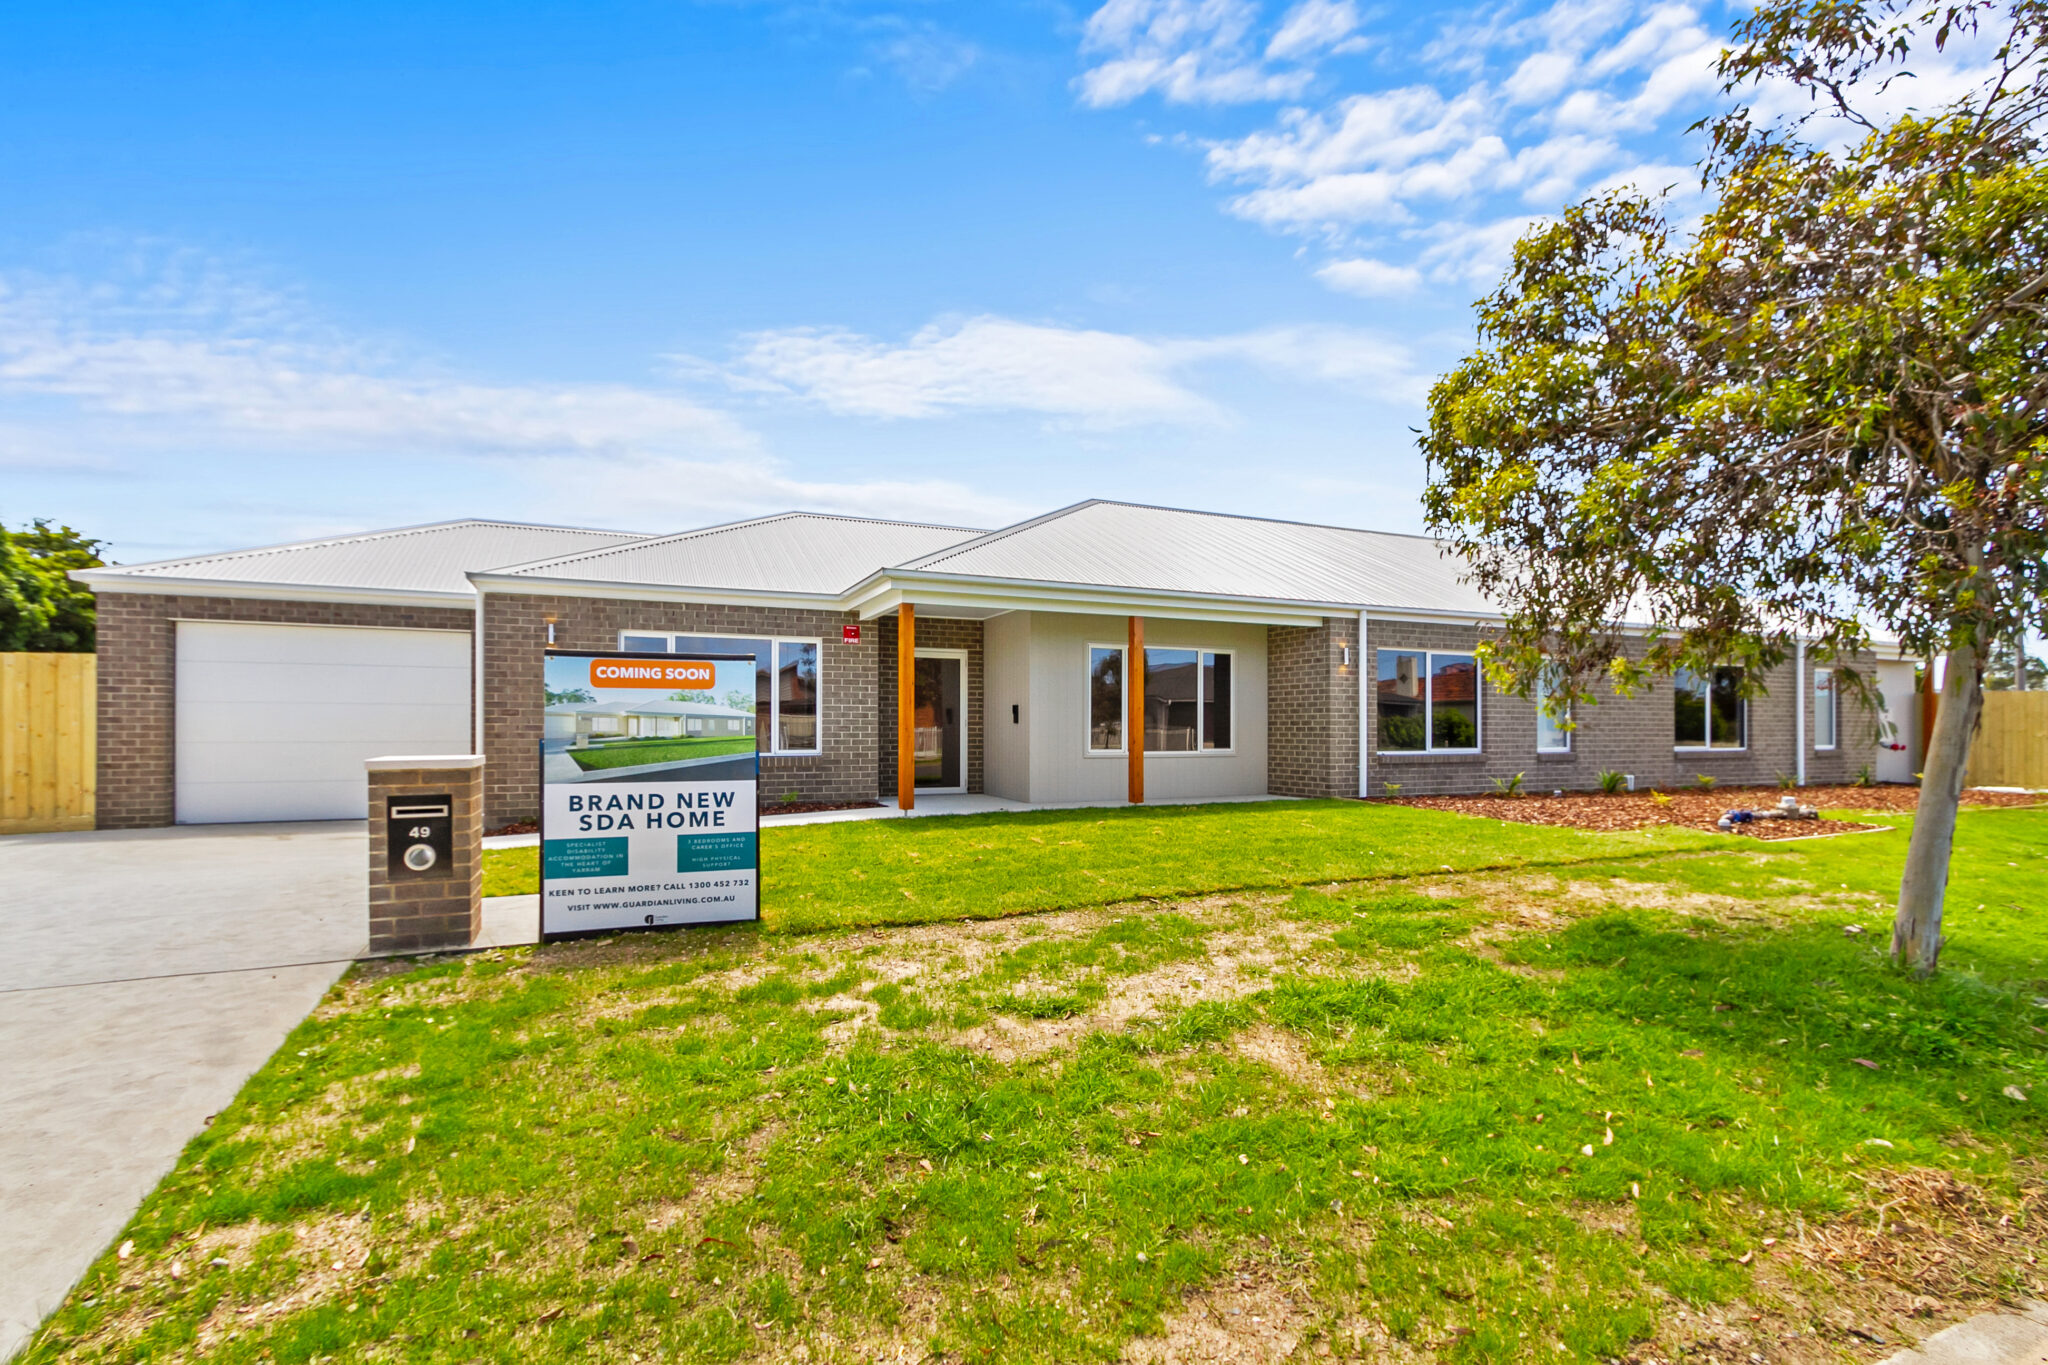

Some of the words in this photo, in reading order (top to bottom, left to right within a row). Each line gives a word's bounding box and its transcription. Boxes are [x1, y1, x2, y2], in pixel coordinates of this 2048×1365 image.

[595, 666, 662, 679] COMING
[665, 668, 710, 680] SOON
[569, 793, 665, 812] BRAND
[677, 791, 736, 809] NEW
[579, 813, 635, 832] SDA
[646, 810, 726, 829] HOME
[408, 826, 431, 838] 49
[547, 854, 614, 862] ACCOMMODATION
[566, 847, 606, 855] DISABILITY
[548, 889, 575, 897] KEEN
[594, 886, 625, 895] LEARN
[628, 884, 661, 892] MORE?
[663, 883, 686, 891] CALL
[689, 881, 711, 889] 1300
[593, 895, 736, 910] WWW.GUARDIANLIVING.COM.AU
